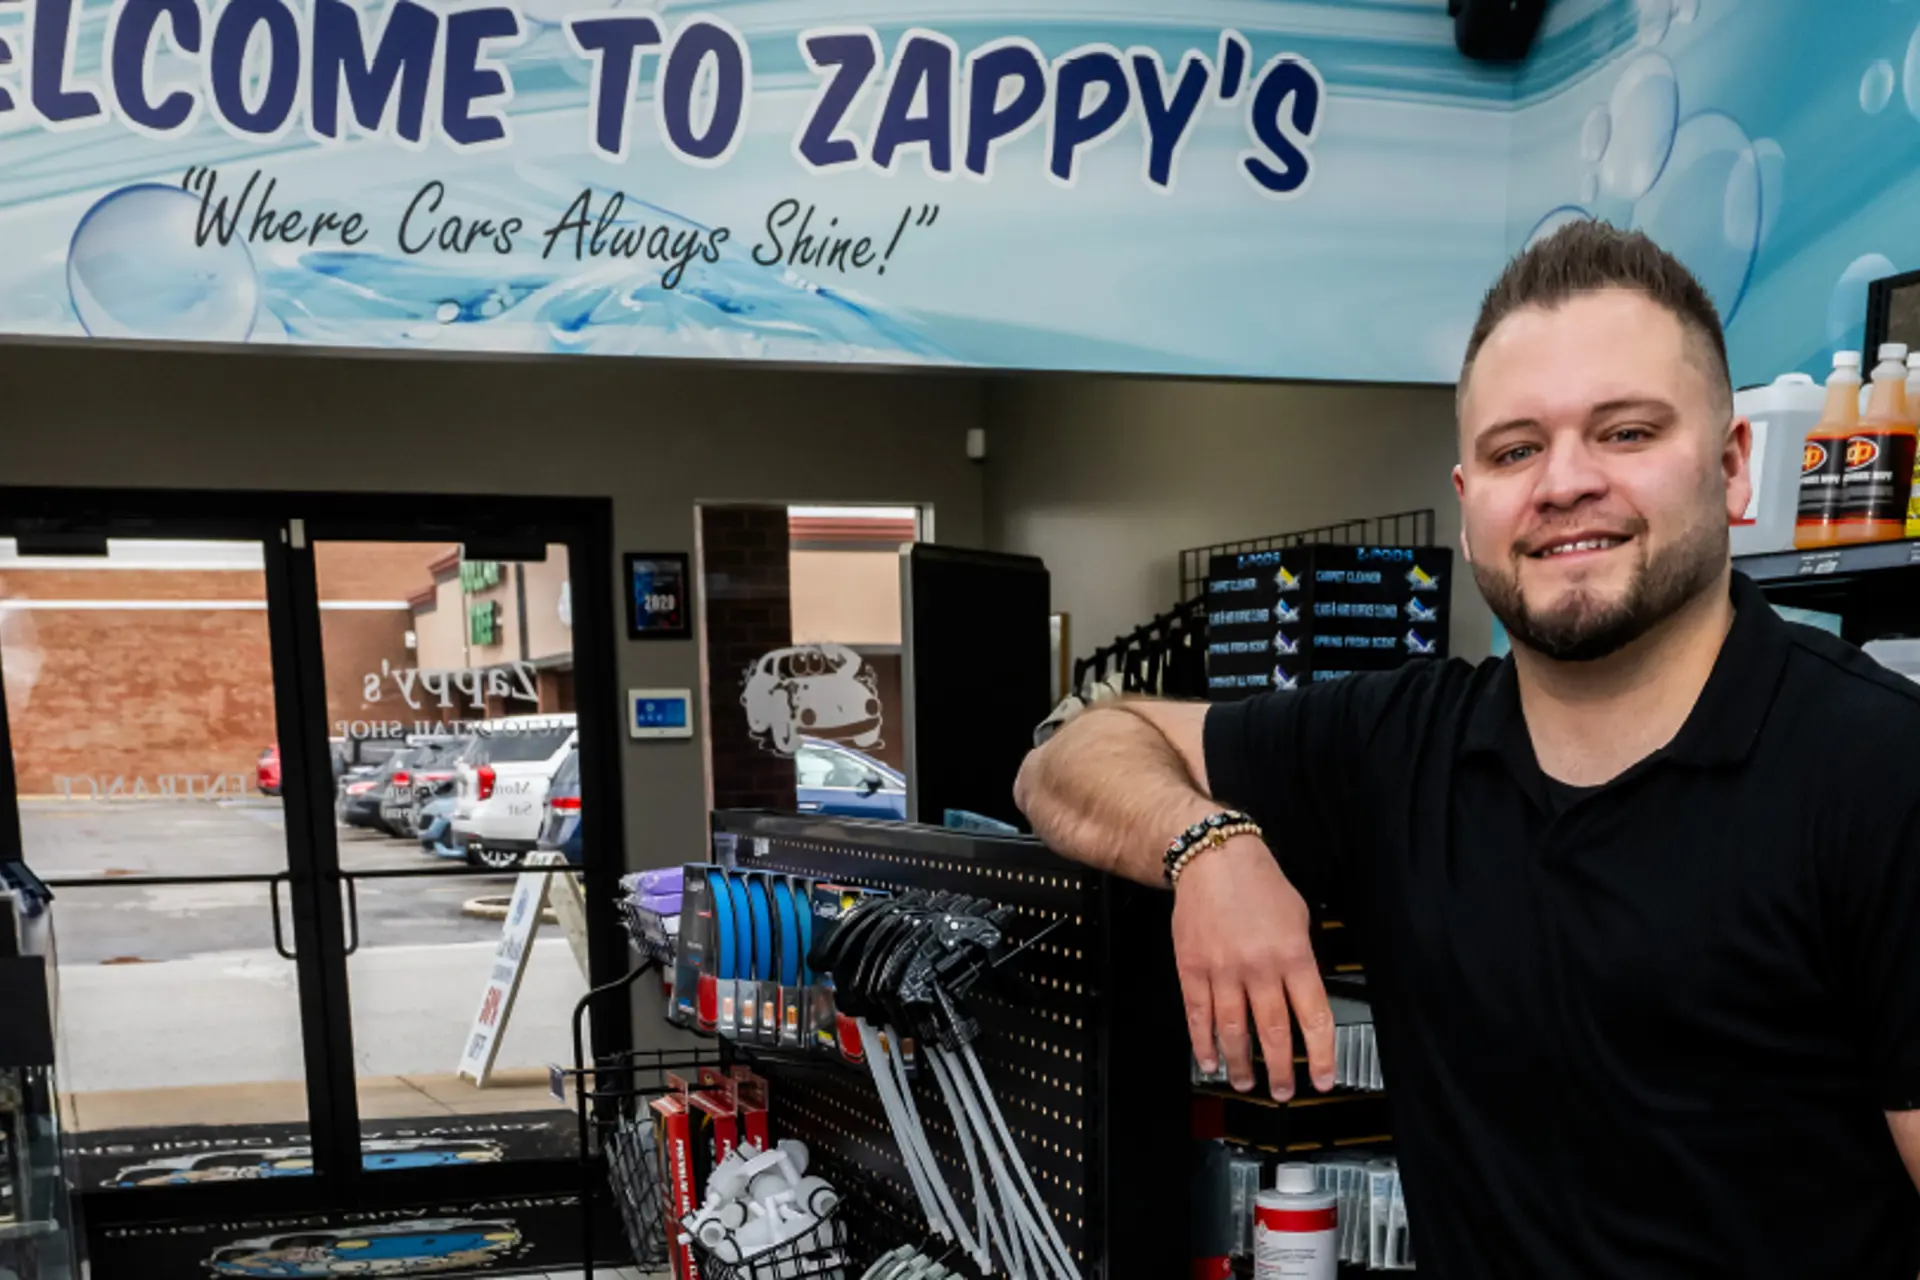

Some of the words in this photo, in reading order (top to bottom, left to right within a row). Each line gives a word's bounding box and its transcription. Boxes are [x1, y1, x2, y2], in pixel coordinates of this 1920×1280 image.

[570, 17, 746, 160] TO
[800, 34, 1320, 193] ZAPPY'S
[397, 180, 524, 255] Cars
[541, 187, 730, 290] Always
